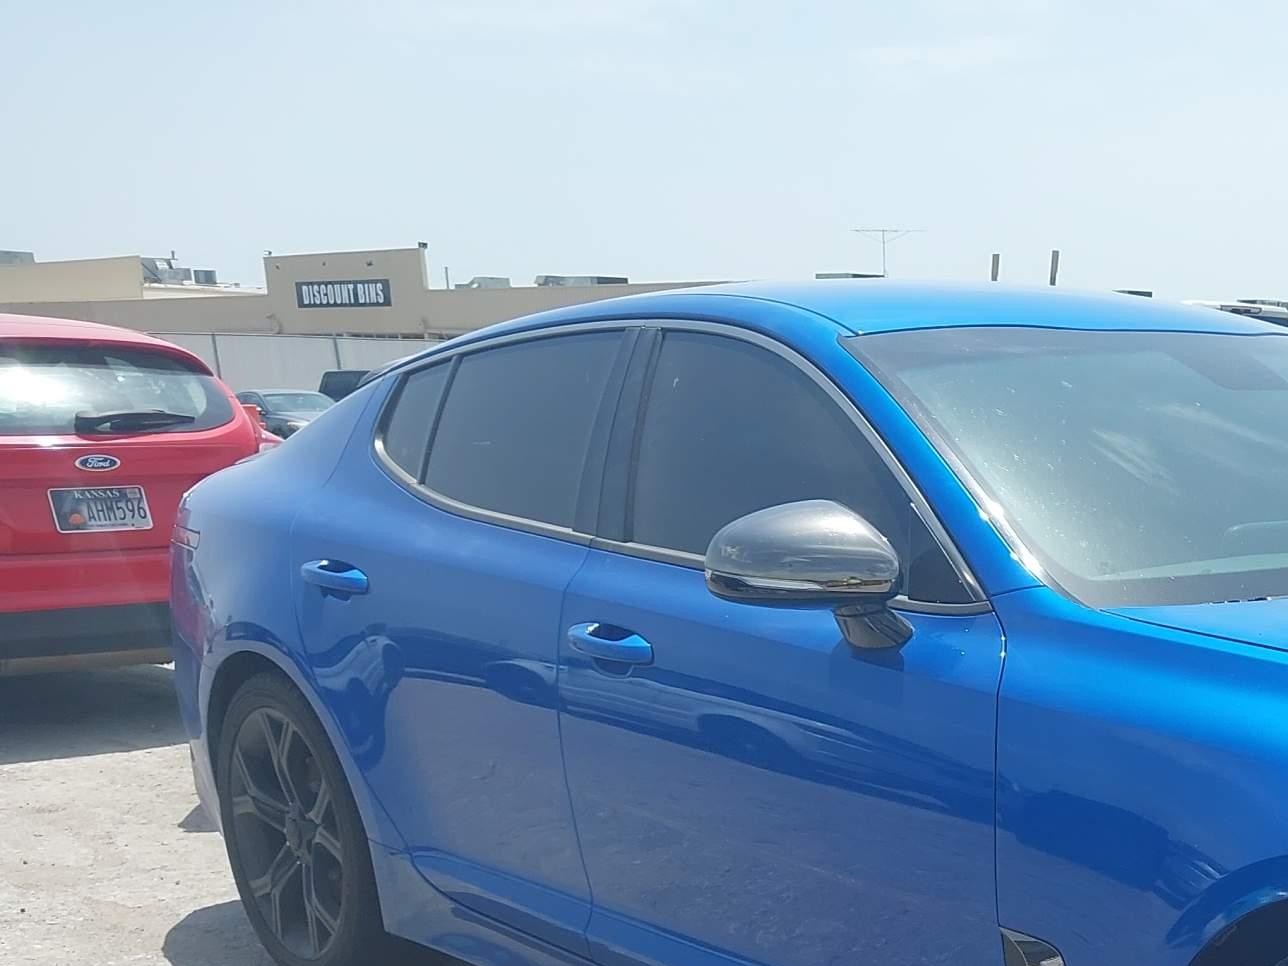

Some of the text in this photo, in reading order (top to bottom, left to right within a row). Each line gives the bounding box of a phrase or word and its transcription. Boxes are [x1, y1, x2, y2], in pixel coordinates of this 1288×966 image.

[301, 282, 385, 305] DISCOUNT BINS
[86, 457, 111, 468] Ford
[73, 489, 120, 499] KANSAS
[87, 500, 147, 522] AHM596
